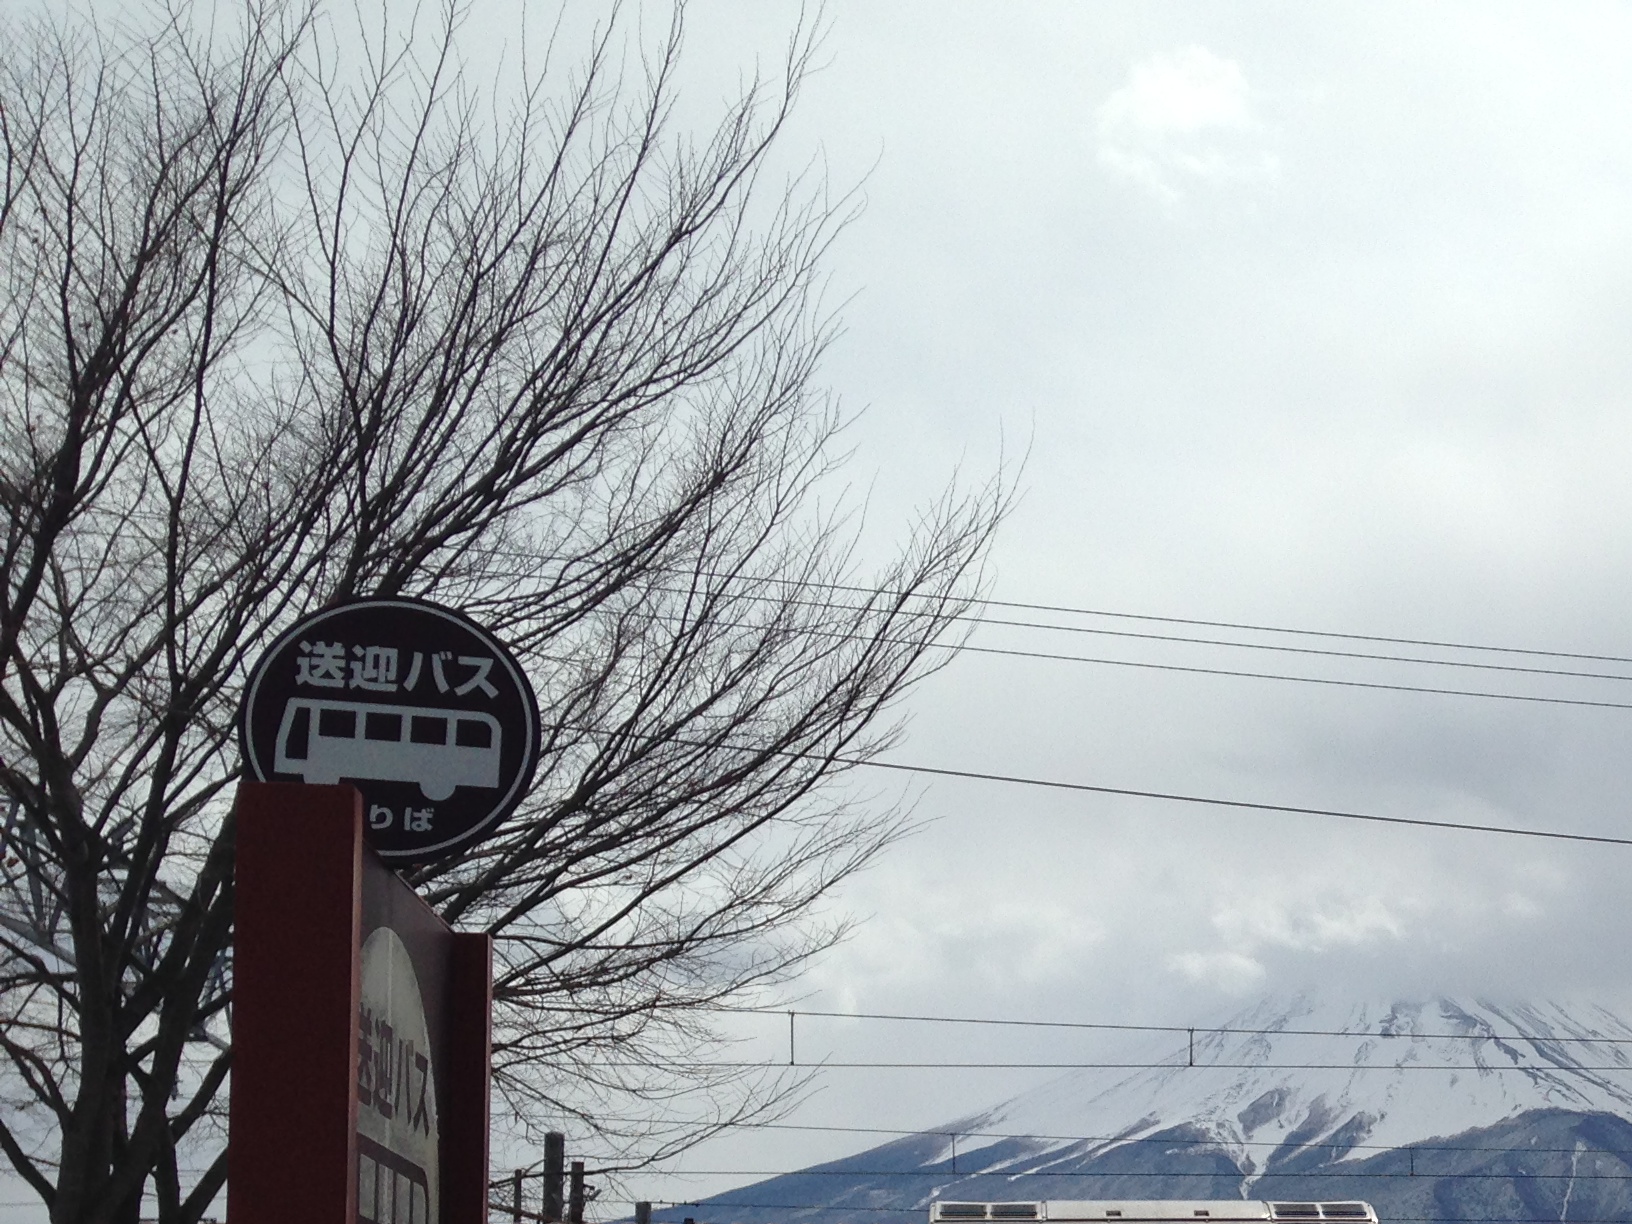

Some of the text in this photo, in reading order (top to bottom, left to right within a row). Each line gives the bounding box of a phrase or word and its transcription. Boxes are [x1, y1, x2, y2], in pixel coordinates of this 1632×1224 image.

[295, 640, 500, 699] 送迎バス
[369, 804, 434, 831] りば
